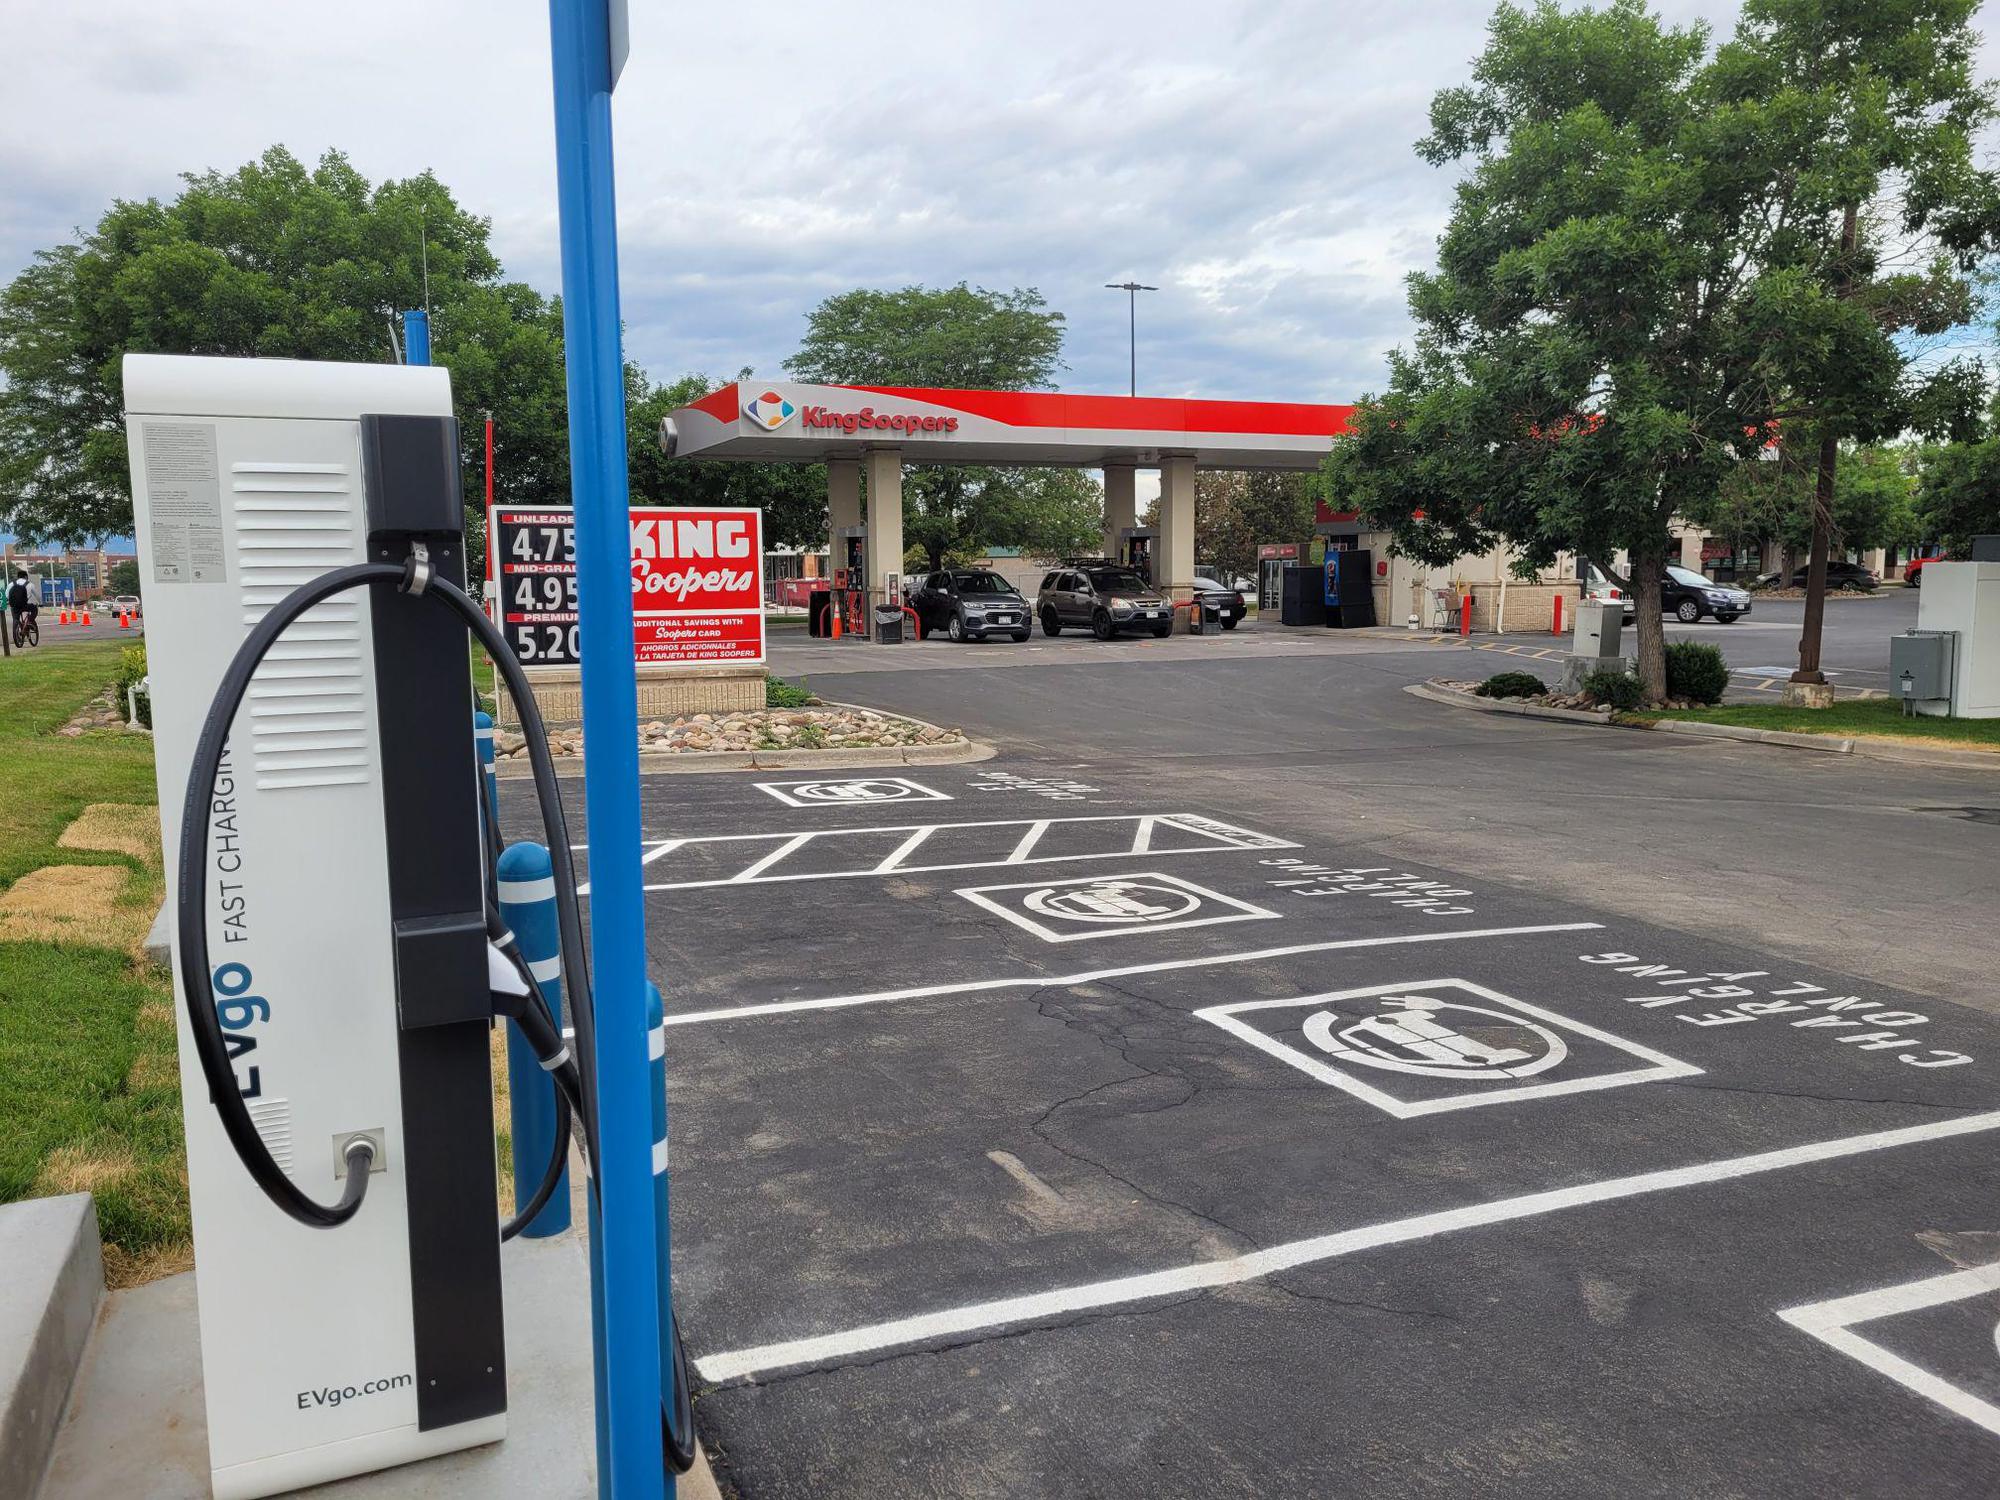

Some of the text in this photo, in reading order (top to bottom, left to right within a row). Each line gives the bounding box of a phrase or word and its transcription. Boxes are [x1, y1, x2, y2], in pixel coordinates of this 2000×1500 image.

[802, 406, 958, 435] KingSoopers
[513, 515, 575, 524] UNLEADE
[512, 528, 576, 561] 4.75
[629, 520, 749, 558] KING
[513, 564, 577, 573] MID-GRA
[631, 559, 753, 602] Soopers
[515, 577, 578, 611] 4.95
[523, 613, 579, 622] PREMIU
[655, 627, 697, 640] Soopers
[518, 625, 580, 660] 5.20
[213, 734, 248, 943] FAST CHARGIN
[1258, 858, 1475, 916] CHARGING
[1264, 879, 1351, 896] EV
[1343, 867, 1474, 898] ONLY
[1578, 952, 1974, 1068] CHARGING
[1623, 995, 1759, 1027] EV
[1706, 970, 1930, 1027] ONLY
[297, 1373, 412, 1410] EVgo.com
